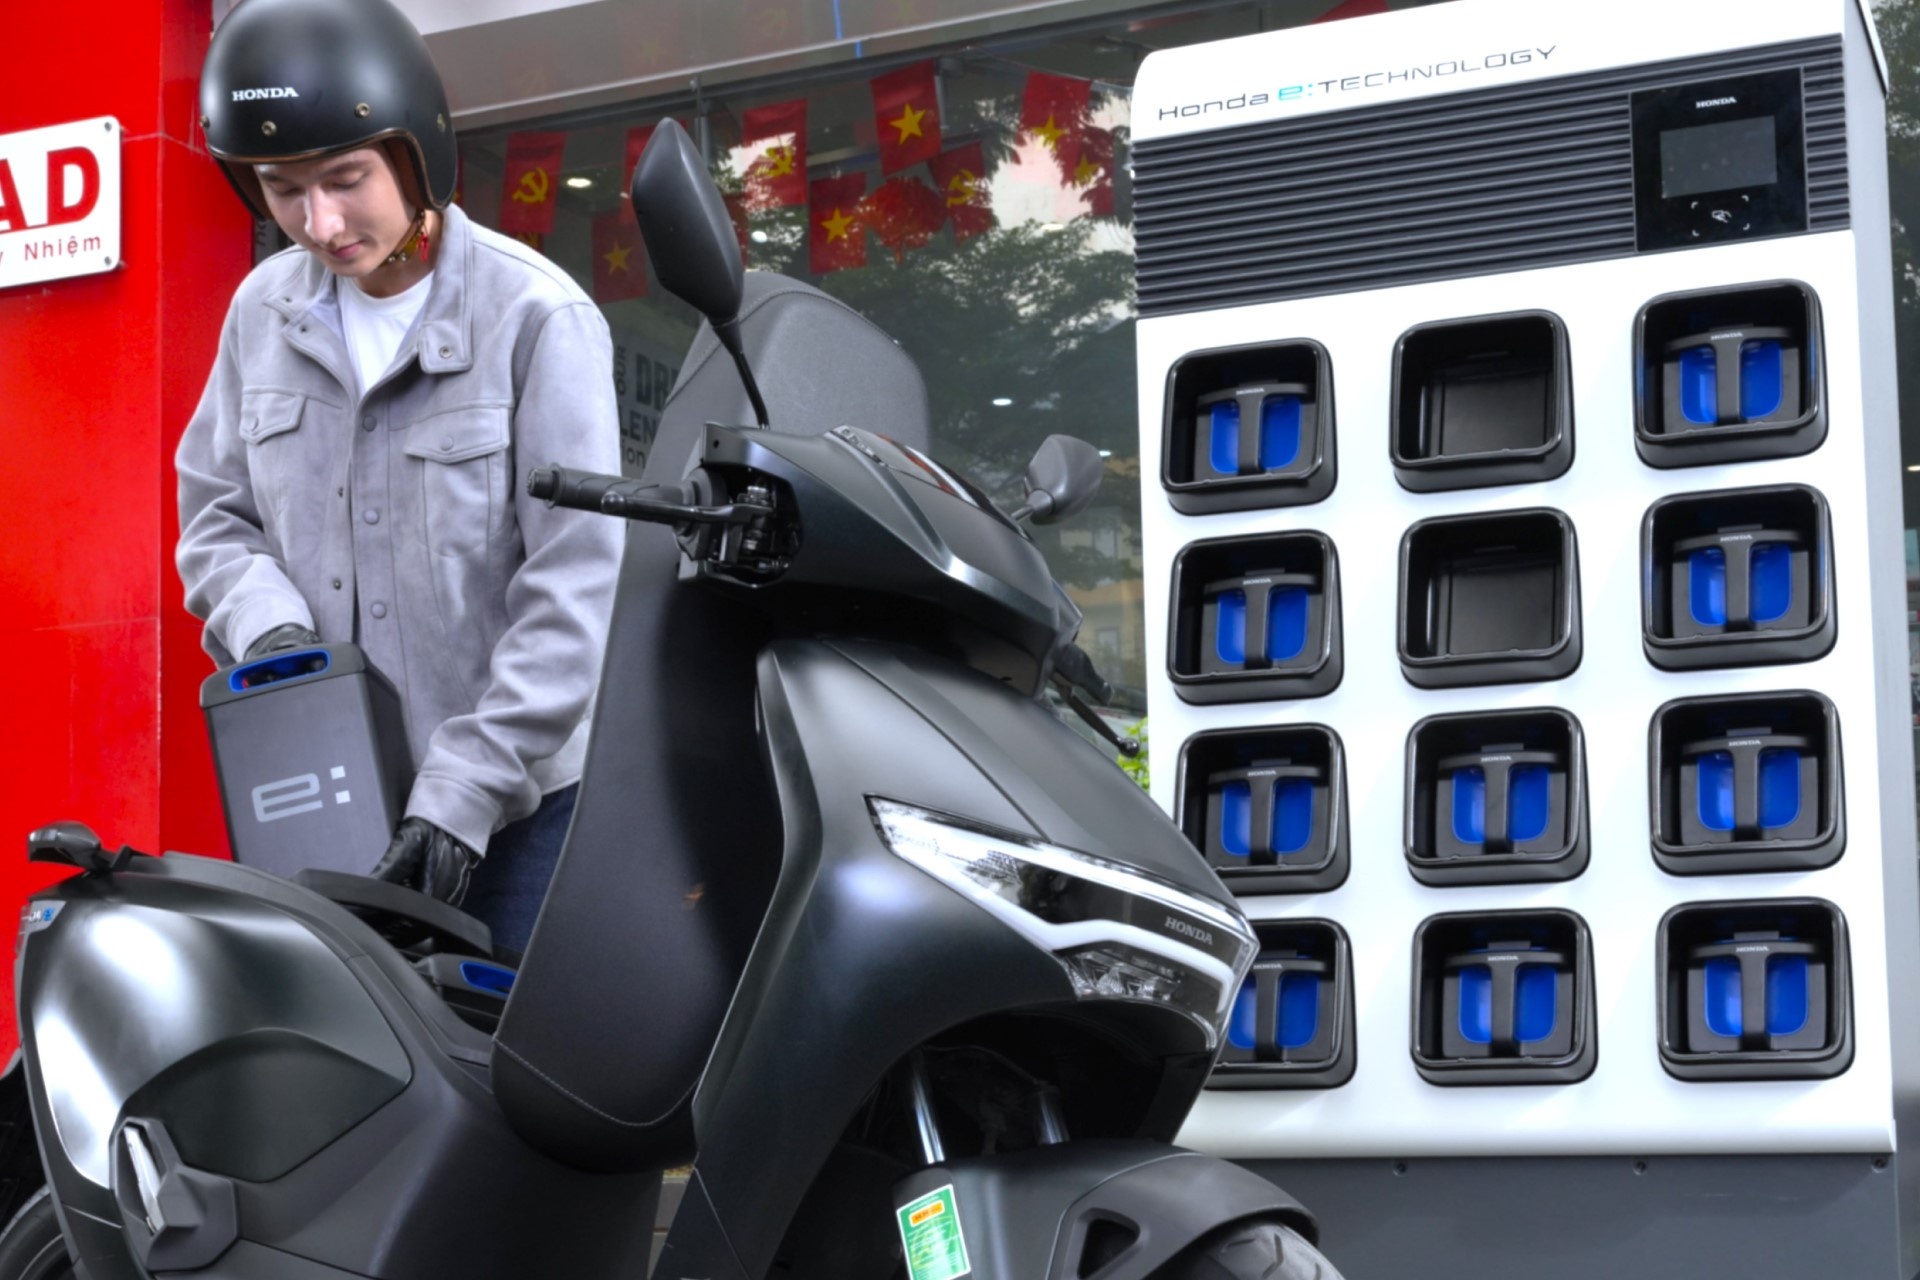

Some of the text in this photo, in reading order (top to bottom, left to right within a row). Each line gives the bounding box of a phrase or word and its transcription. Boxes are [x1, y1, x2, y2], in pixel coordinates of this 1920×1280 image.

[232, 86, 299, 101] HONDA
[1158, 93, 1269, 120] Honda
[1695, 97, 1737, 108] HONDA
[25, 236, 101, 261] Nhiệm
[251, 765, 351, 822] e:
[1164, 916, 1213, 946] HONDA
